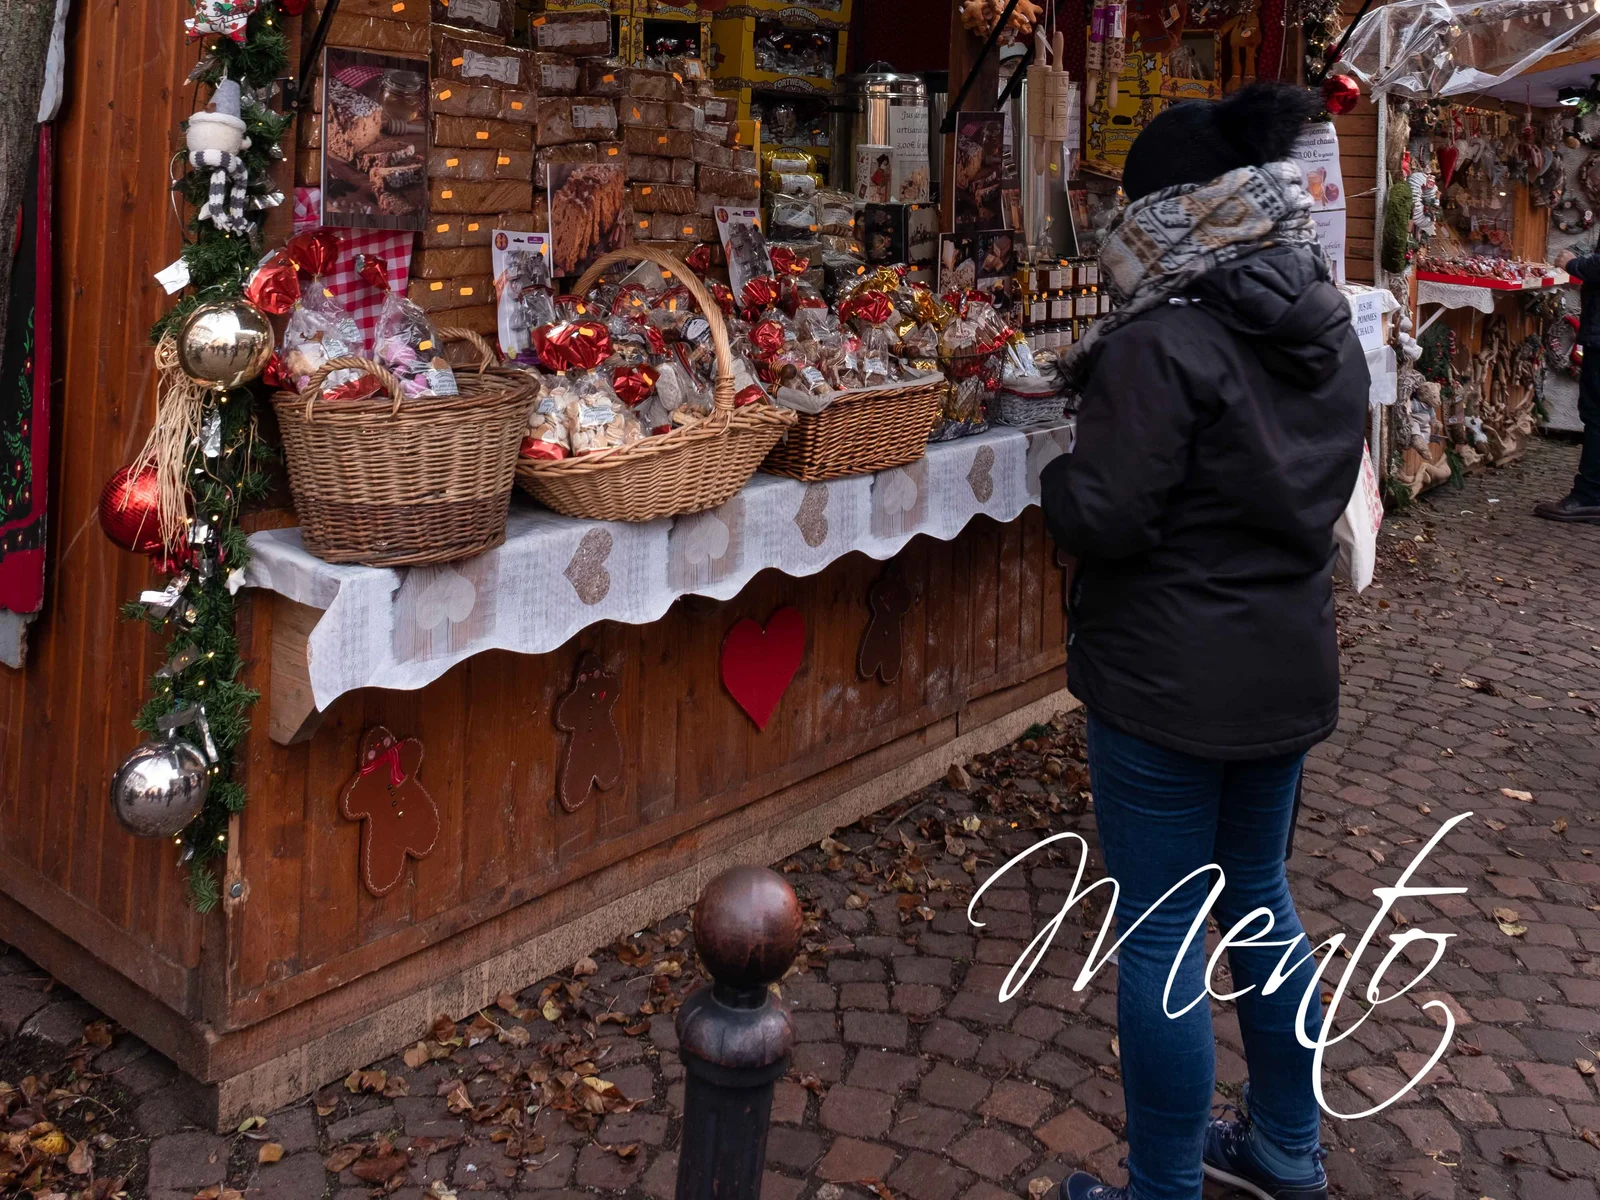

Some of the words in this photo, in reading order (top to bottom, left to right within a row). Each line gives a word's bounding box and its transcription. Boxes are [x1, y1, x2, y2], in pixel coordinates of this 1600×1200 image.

[659, 6, 692, 17] FORTWENGER
[778, 7, 820, 24] FORTWENGER
[774, 78, 815, 92] FORTWENGER
[1358, 303, 1366, 312] JUS
[1367, 301, 1373, 310] DE
[1357, 312, 1378, 324] POMMES
[1356, 325, 1374, 337] CHAUD
